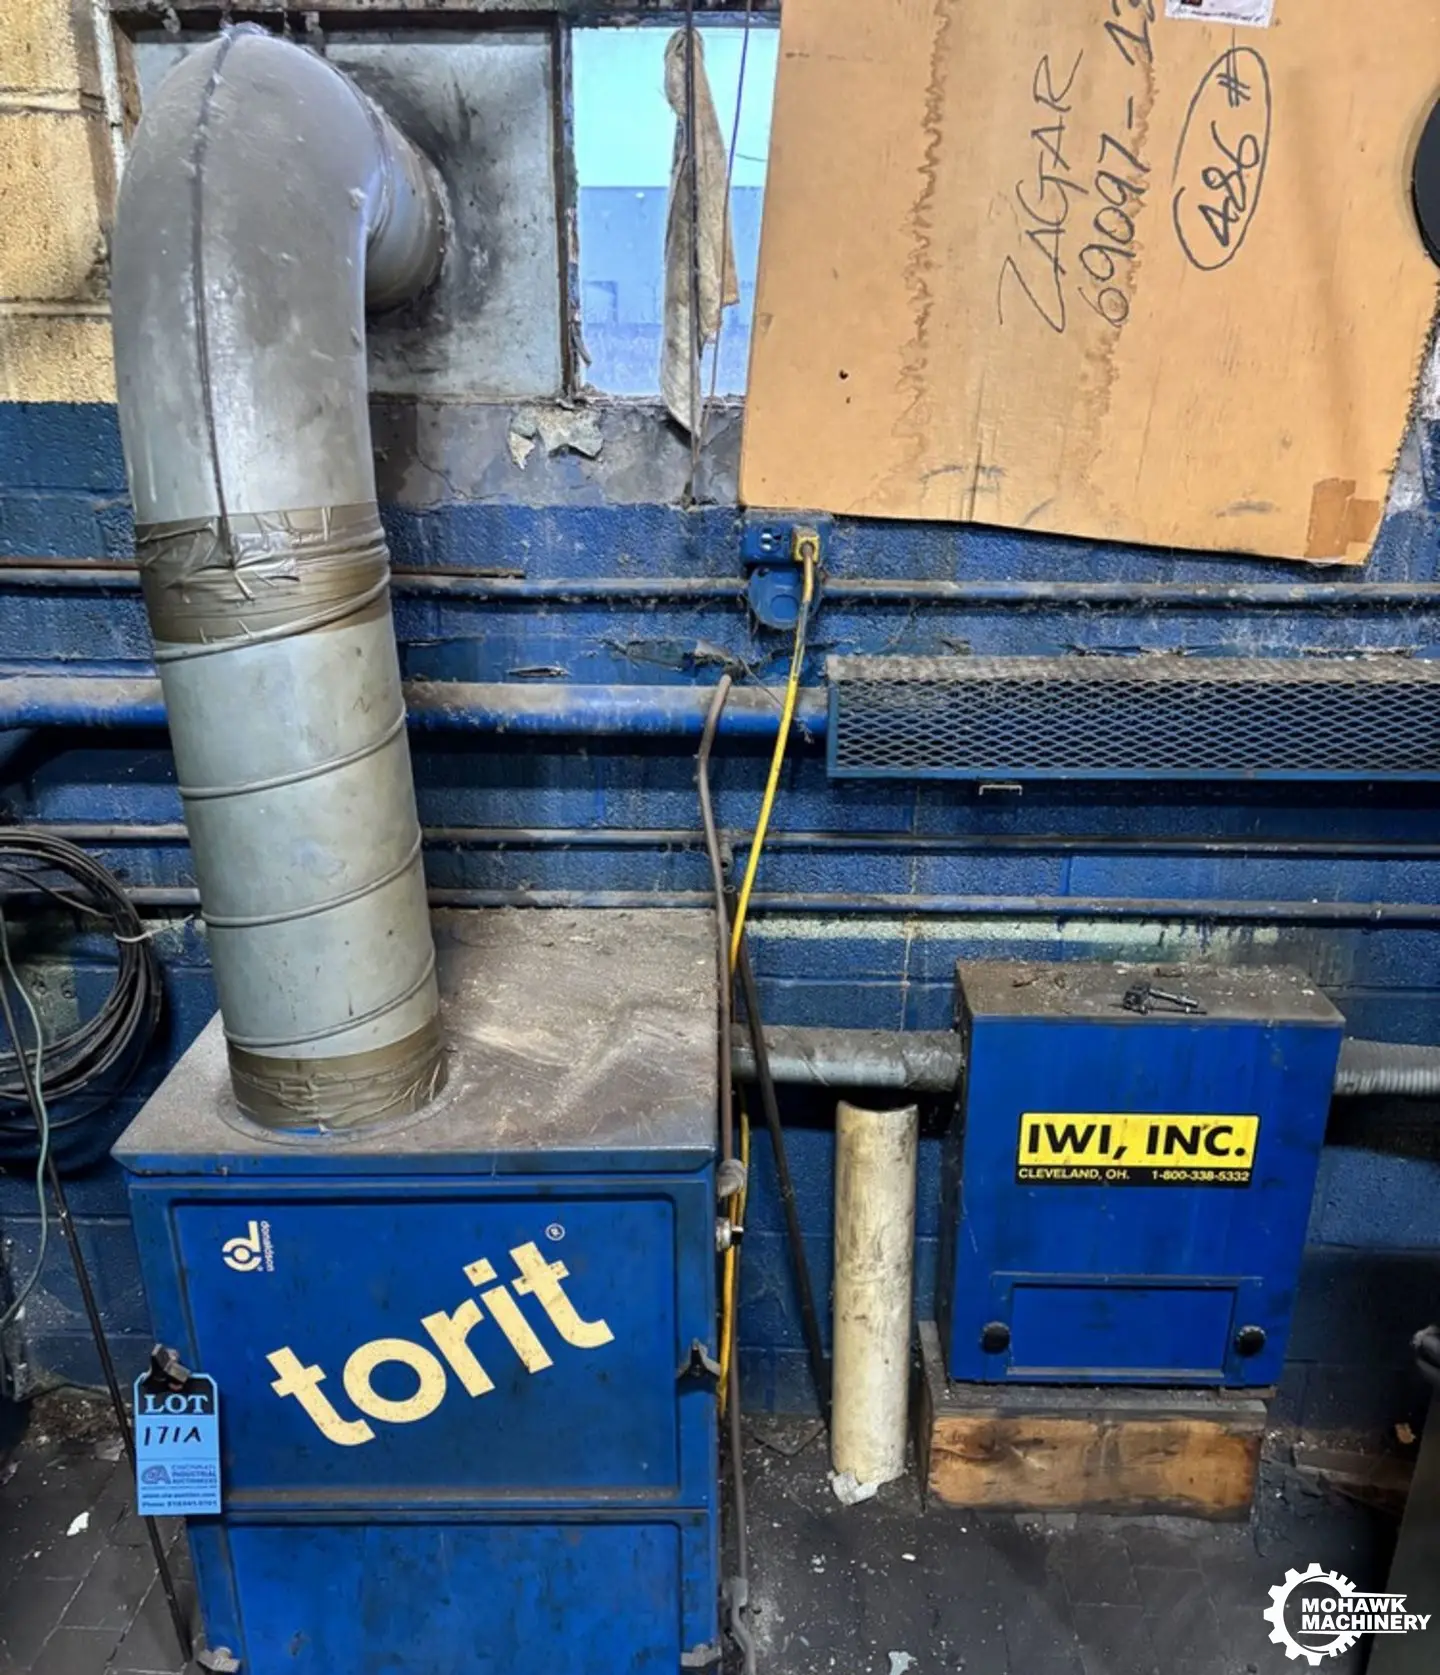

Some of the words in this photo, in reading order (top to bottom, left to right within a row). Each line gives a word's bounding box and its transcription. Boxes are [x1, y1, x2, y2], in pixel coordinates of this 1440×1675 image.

[998, 48, 1089, 333] ZAGAR
[1028, 1124, 1127, 1160] IWI,
[1146, 1125, 1246, 1157] INC.
[1018, 1168, 1103, 1181] CLEVELAND,
[1105, 1168, 1131, 1181] OH.
[265, 1241, 615, 1446] torit
[144, 1393, 208, 1414] LOT
[144, 1425, 202, 1446] 171A
